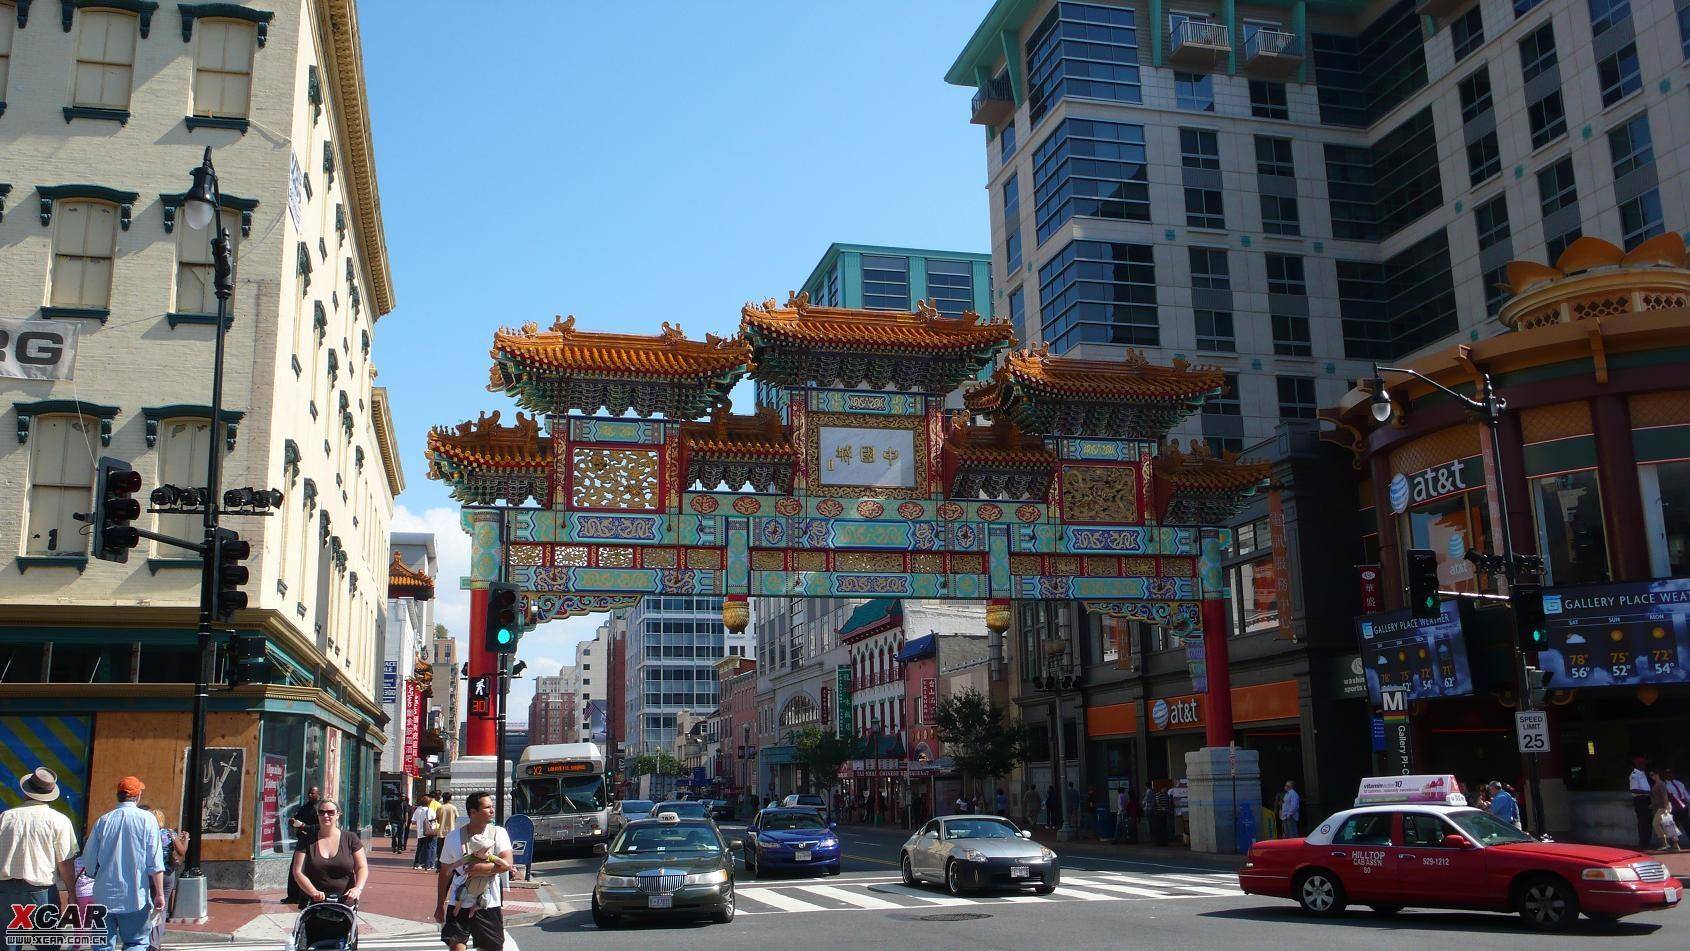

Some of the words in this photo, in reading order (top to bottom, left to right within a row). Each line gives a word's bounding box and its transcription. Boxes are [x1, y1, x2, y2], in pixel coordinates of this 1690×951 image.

[0, 329, 64, 366] G
[1413, 459, 1467, 501] at&t
[1564, 596, 1615, 610] GALLERY
[1620, 593, 1655, 606] PLACE
[1373, 621, 1399, 635] GALLERY
[1399, 618, 1418, 630] PLACE
[1571, 666, 1590, 679] 56°
[1612, 664, 1631, 677] 52°
[1654, 662, 1675, 675] 54°
[1382, 691, 1403, 711] M
[1170, 697, 1198, 724] at&t
[1397, 725, 1407, 754] Gallery
[1523, 734, 1545, 749] 25
[533, 766, 543, 775] X2
[1351, 850, 1386, 860] HILLTOP
[1422, 857, 1450, 866] 529-1212
